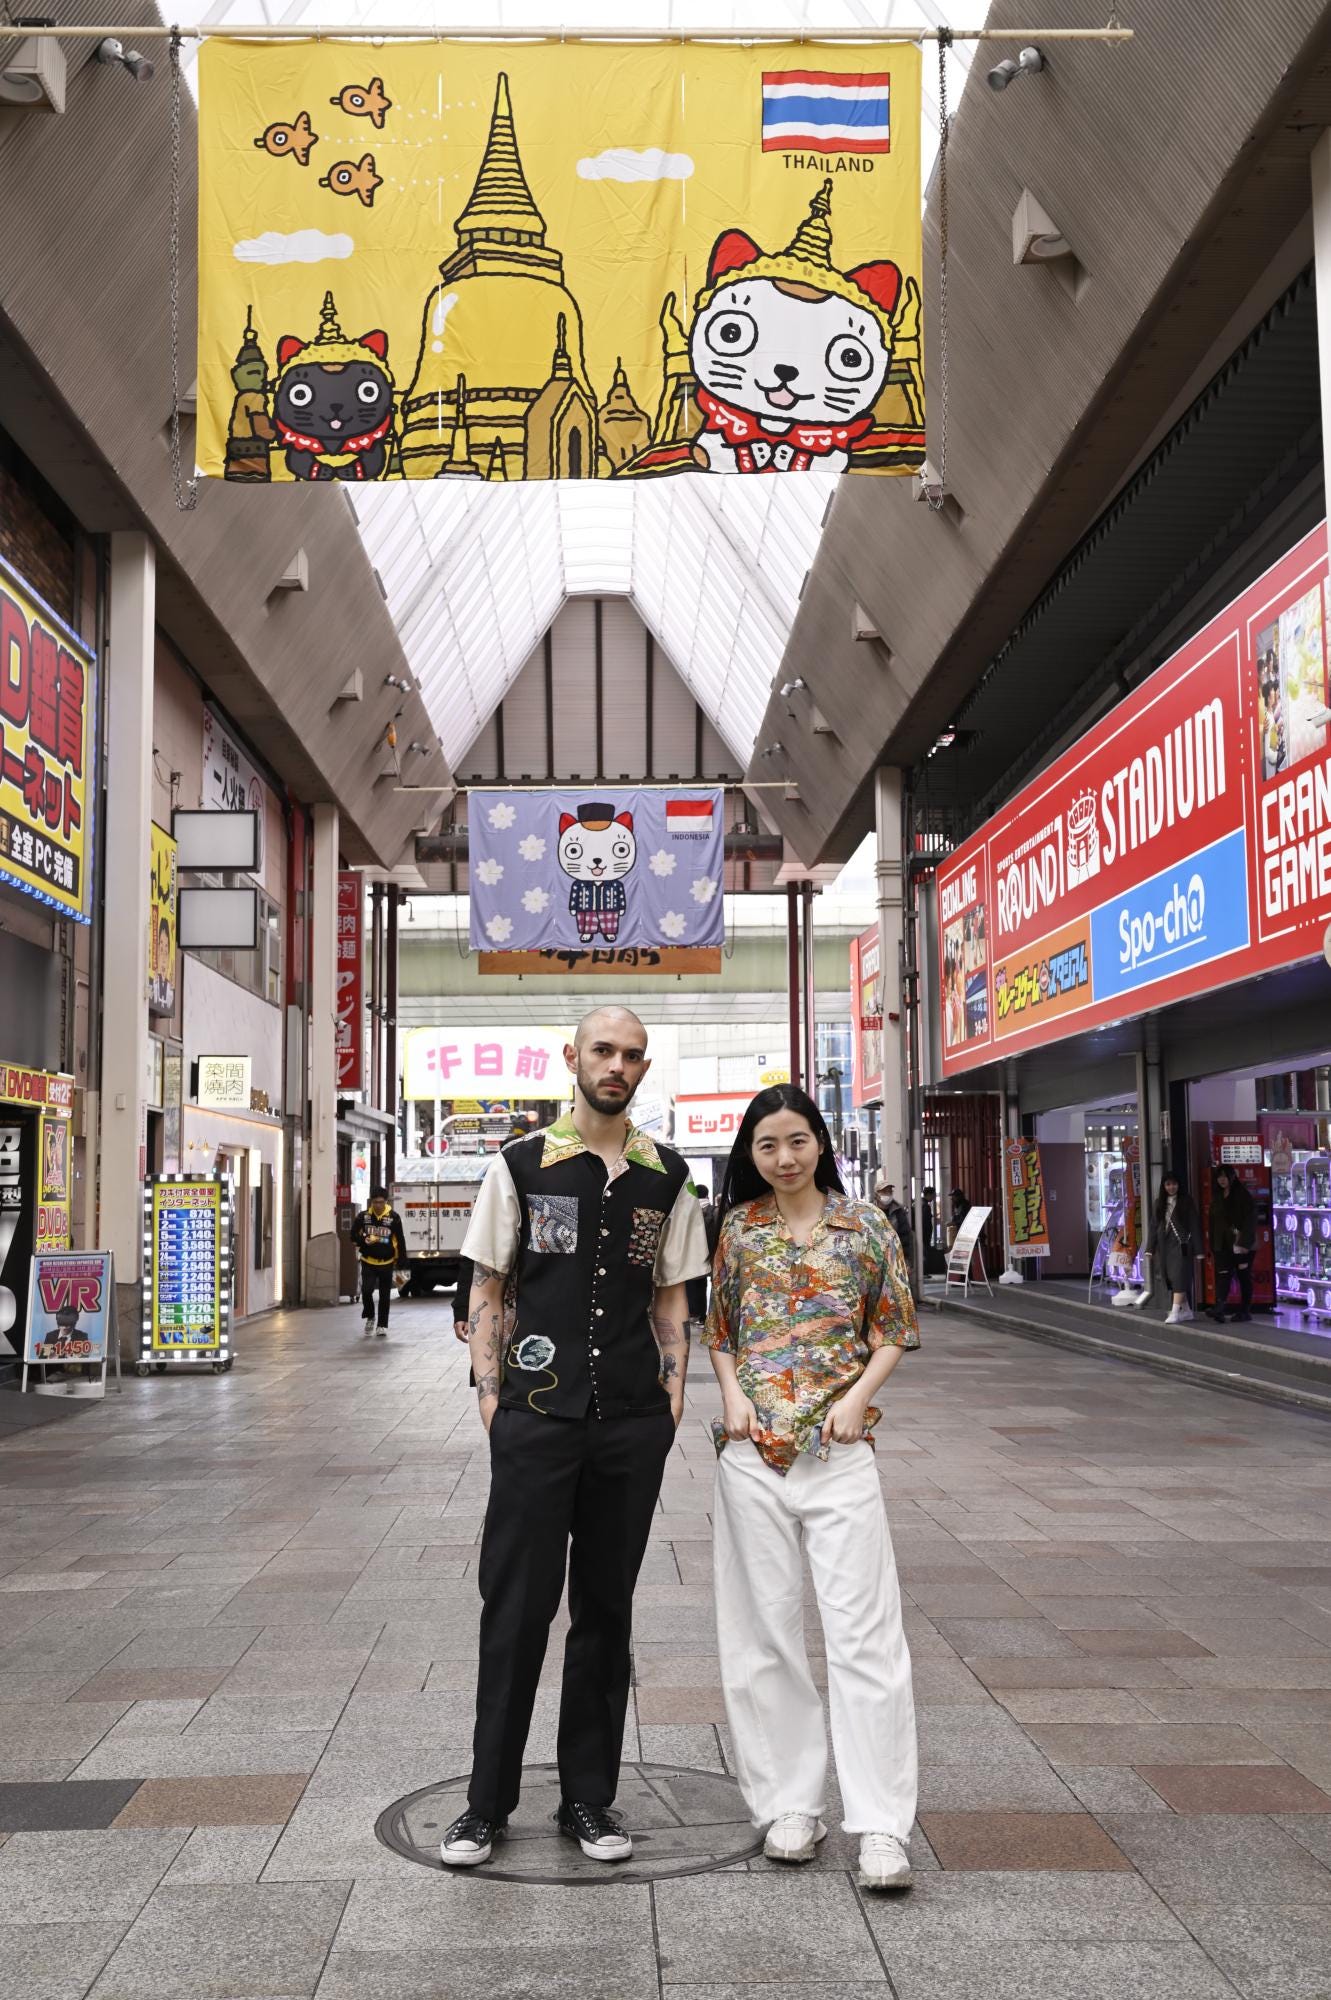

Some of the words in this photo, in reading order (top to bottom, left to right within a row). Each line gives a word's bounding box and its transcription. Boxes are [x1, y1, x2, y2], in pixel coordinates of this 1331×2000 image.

[783, 155, 874, 173] THAILAND
[1101, 697, 1226, 866] STADIUM
[942, 865, 977, 924] BOWLING
[997, 814, 1064, 936] ROUND1
[160, 1198, 214, 1206] インターネット
[39, 1277, 102, 1314] VR
